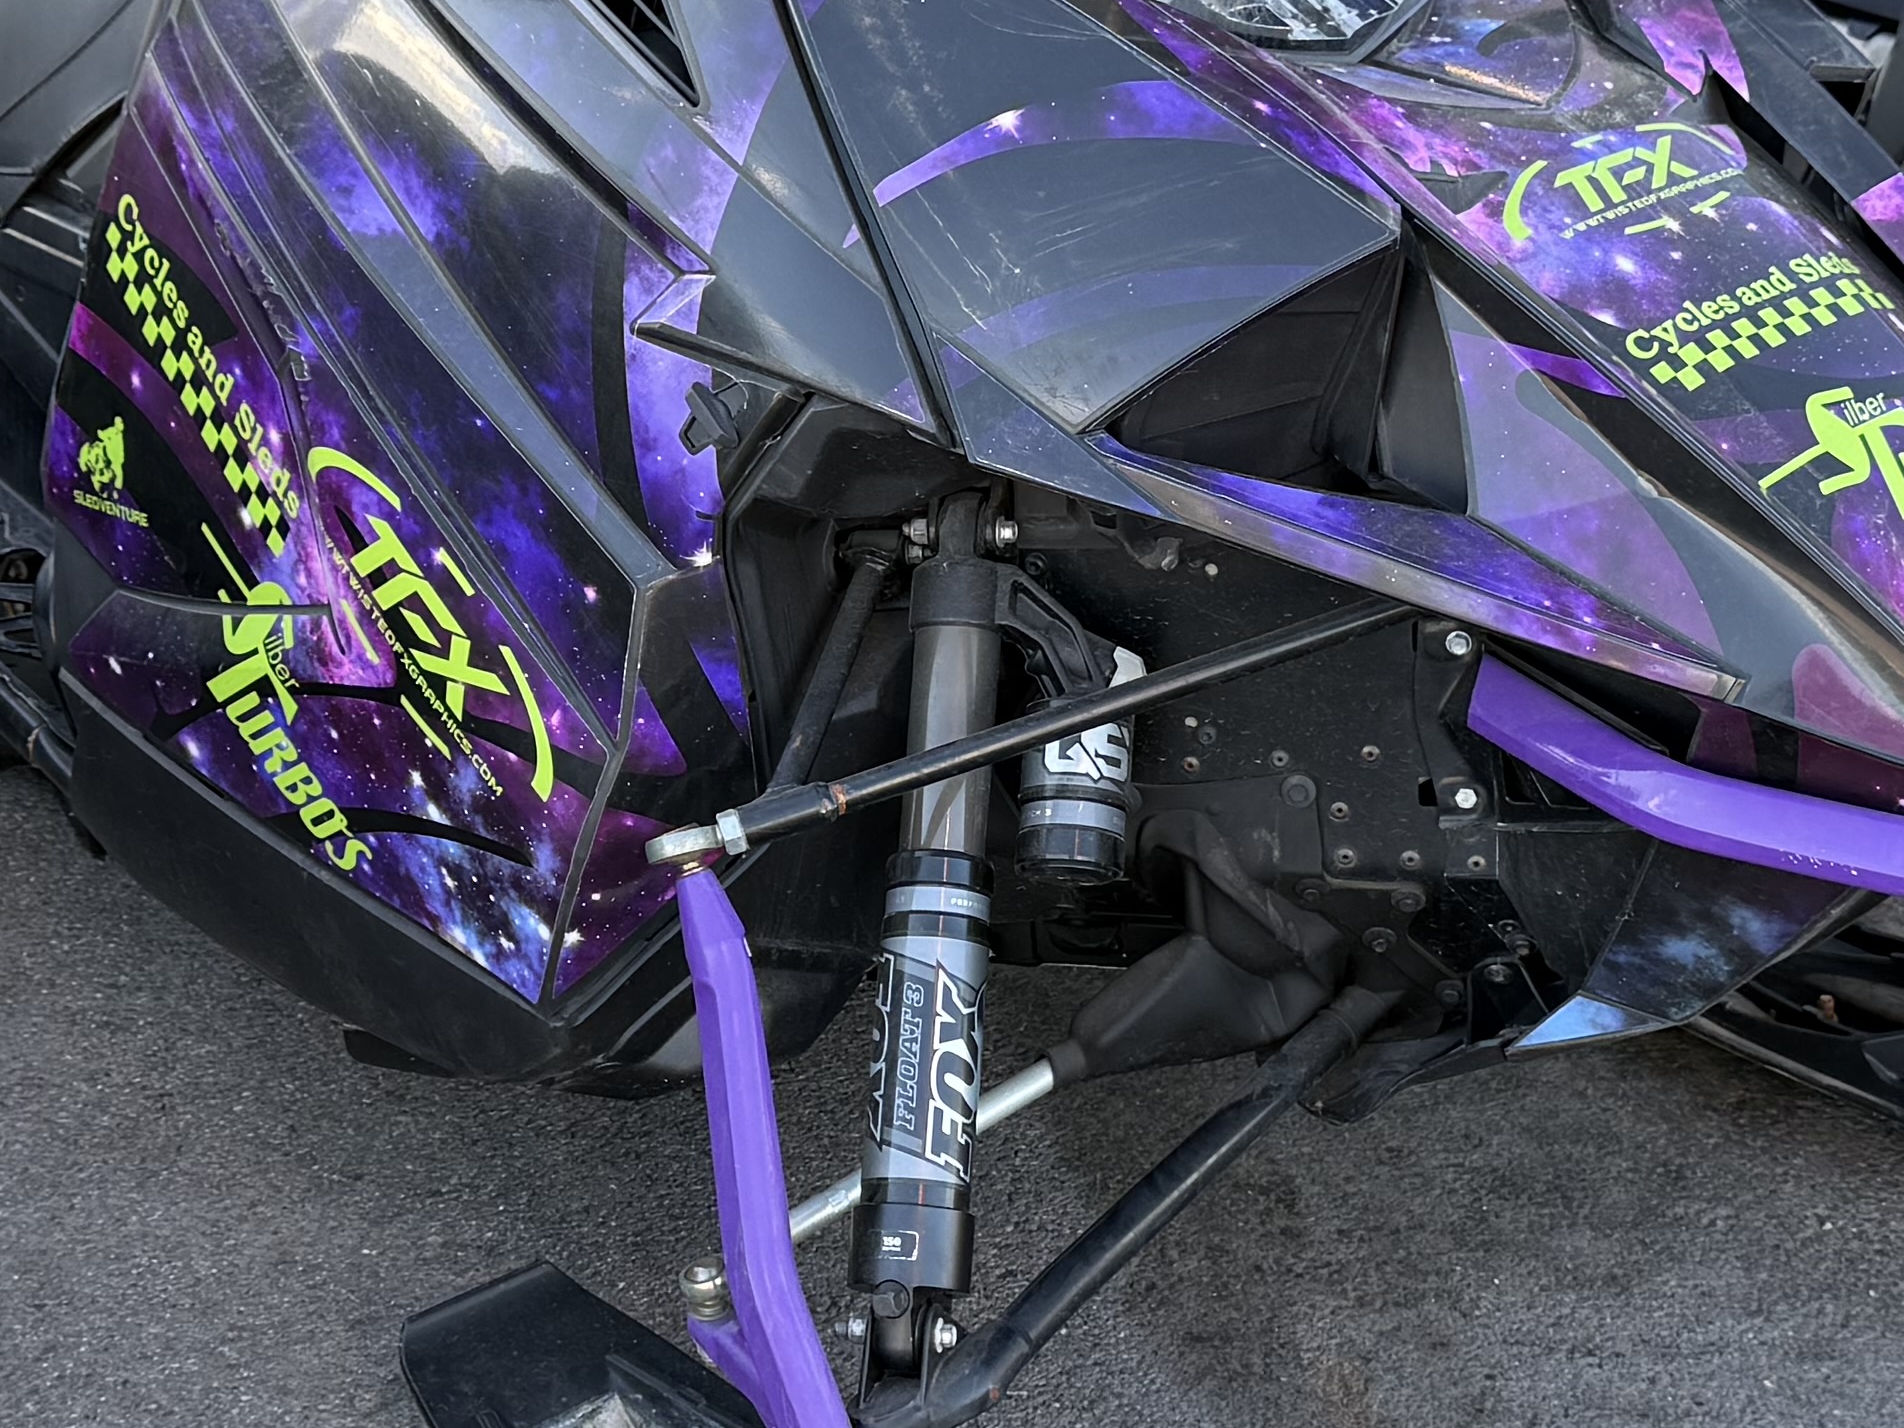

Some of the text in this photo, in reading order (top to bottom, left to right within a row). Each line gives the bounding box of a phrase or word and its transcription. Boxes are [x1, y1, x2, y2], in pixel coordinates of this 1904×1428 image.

[117, 193, 300, 519] Cycles and Sleds
[1625, 293, 1741, 359] Cycles
[1736, 265, 1796, 307] and
[894, 982, 925, 1131] FLOAT 3
[924, 964, 980, 1184] FOX
[882, 1235, 902, 1246] 150
